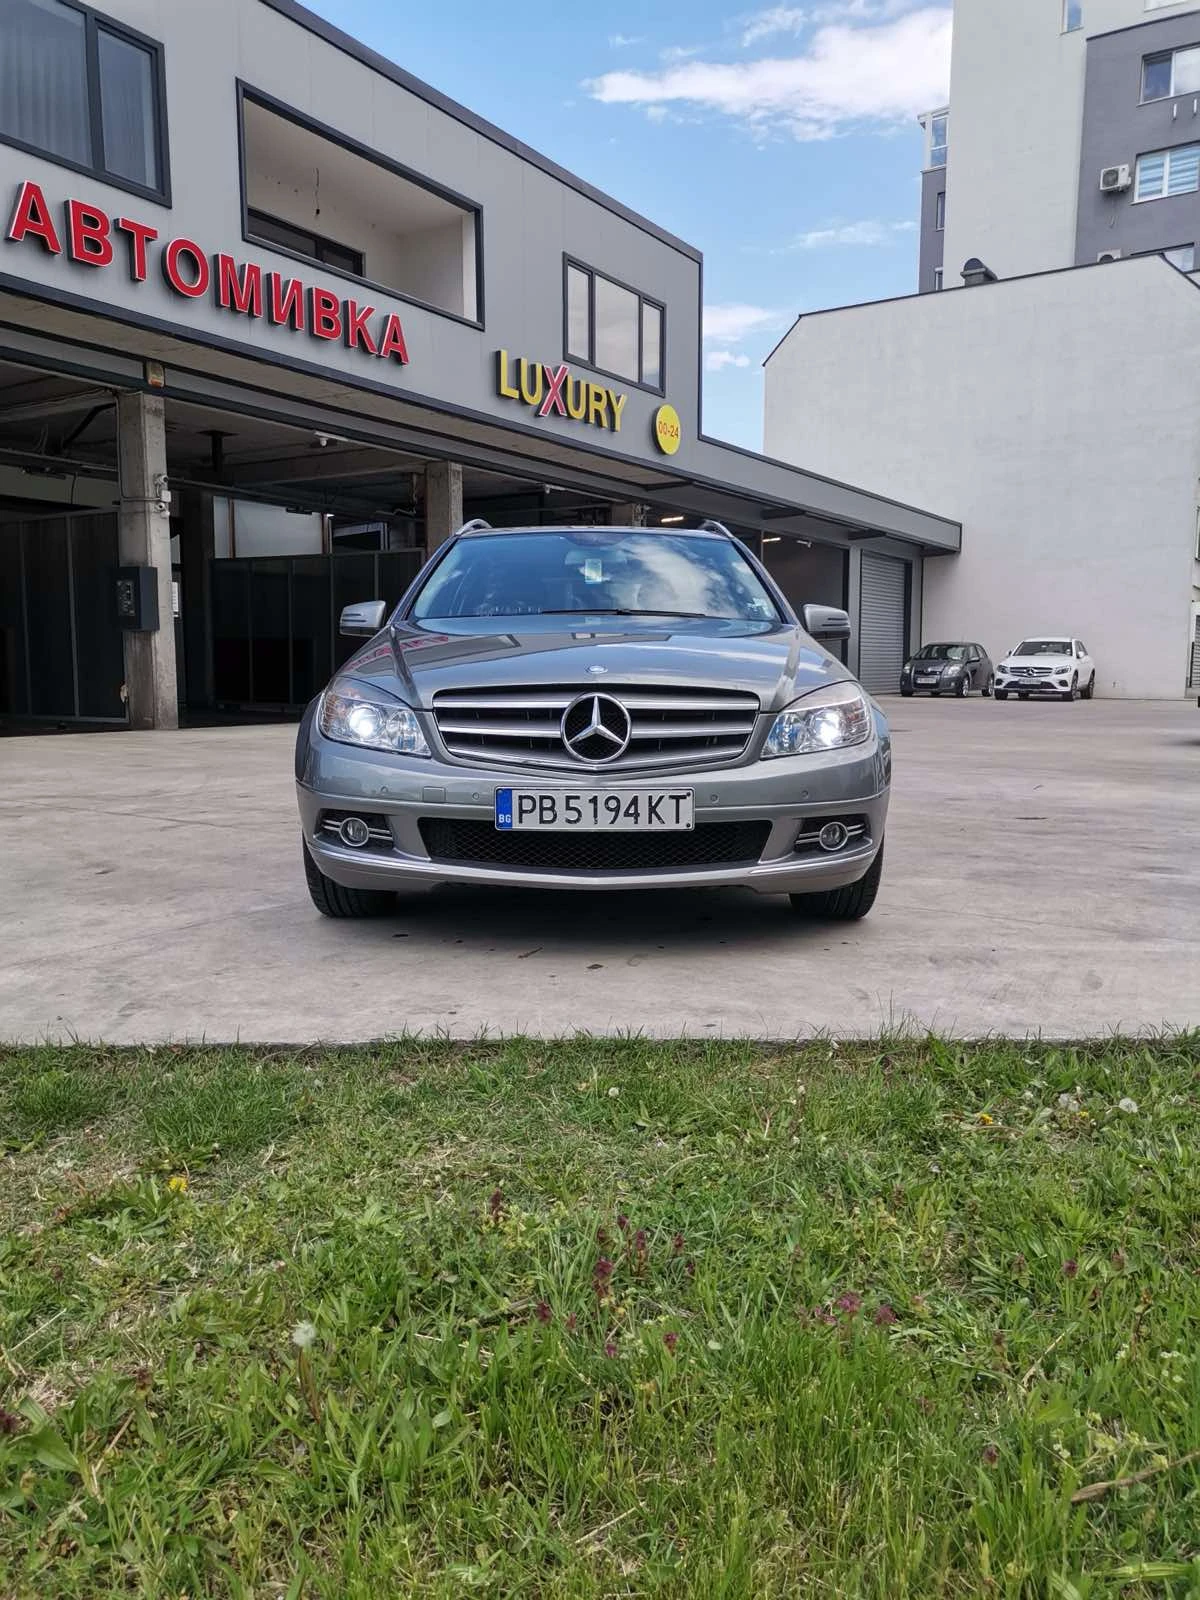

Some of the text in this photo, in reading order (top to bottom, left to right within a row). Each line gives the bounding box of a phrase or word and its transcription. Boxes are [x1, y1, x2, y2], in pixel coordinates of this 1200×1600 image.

[8, 180, 410, 365] АВТОМИВКА
[498, 349, 626, 432] LUXURY
[658, 420, 679, 439] 00-24
[498, 814, 512, 823] BG
